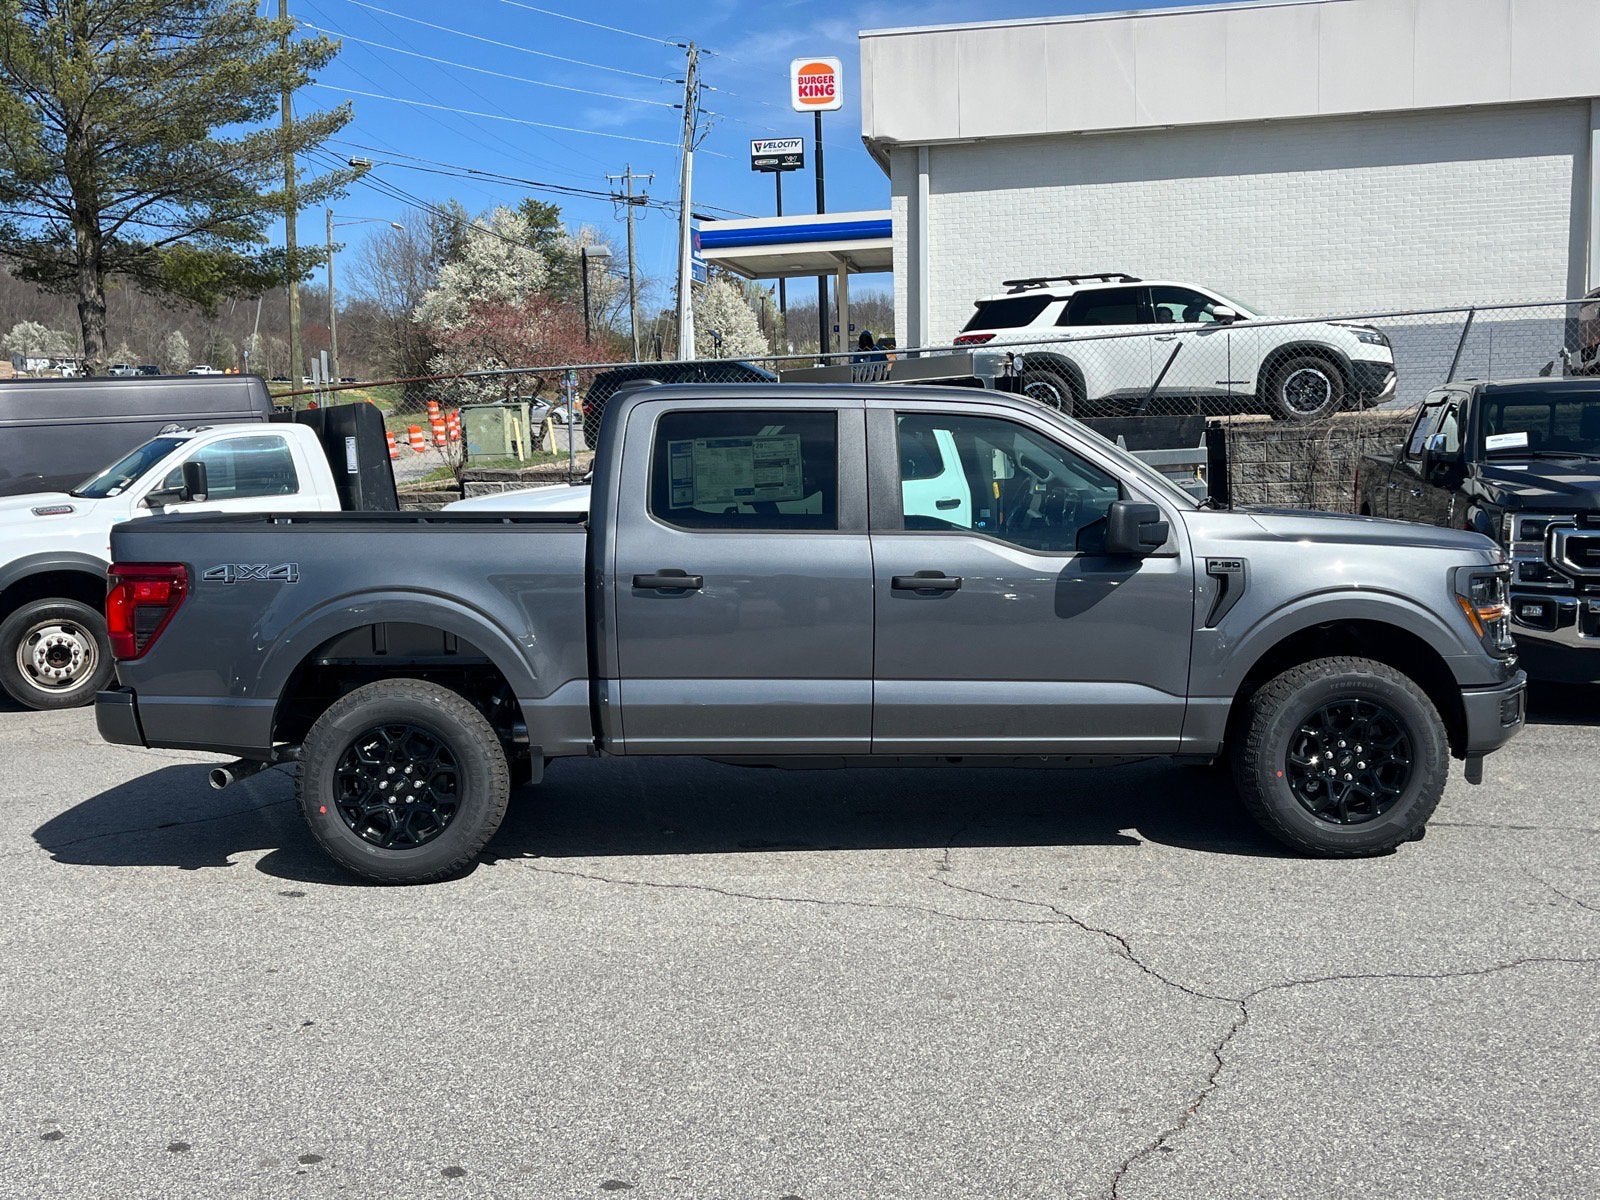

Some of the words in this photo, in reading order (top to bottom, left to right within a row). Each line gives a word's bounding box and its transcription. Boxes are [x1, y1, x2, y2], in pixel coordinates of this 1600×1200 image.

[798, 76, 834, 84] BURGER
[798, 84, 835, 97] KING
[763, 141, 800, 149] VELOCITY
